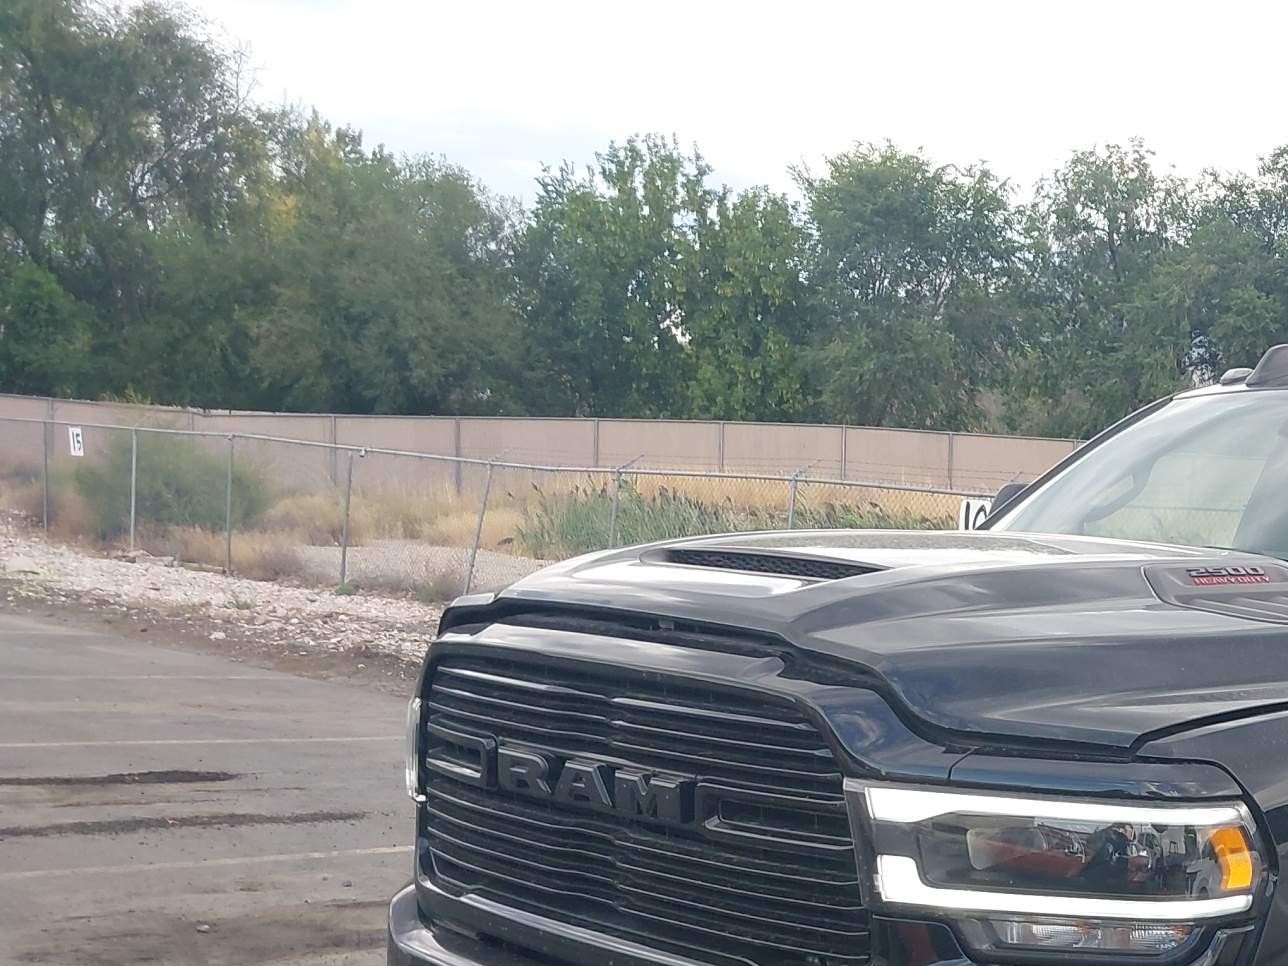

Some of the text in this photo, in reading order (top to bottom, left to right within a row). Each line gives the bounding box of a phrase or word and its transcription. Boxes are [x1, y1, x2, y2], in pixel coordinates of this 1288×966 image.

[71, 431, 82, 451] 15
[1187, 566, 1265, 577] 2500
[497, 745, 690, 823] RAM
